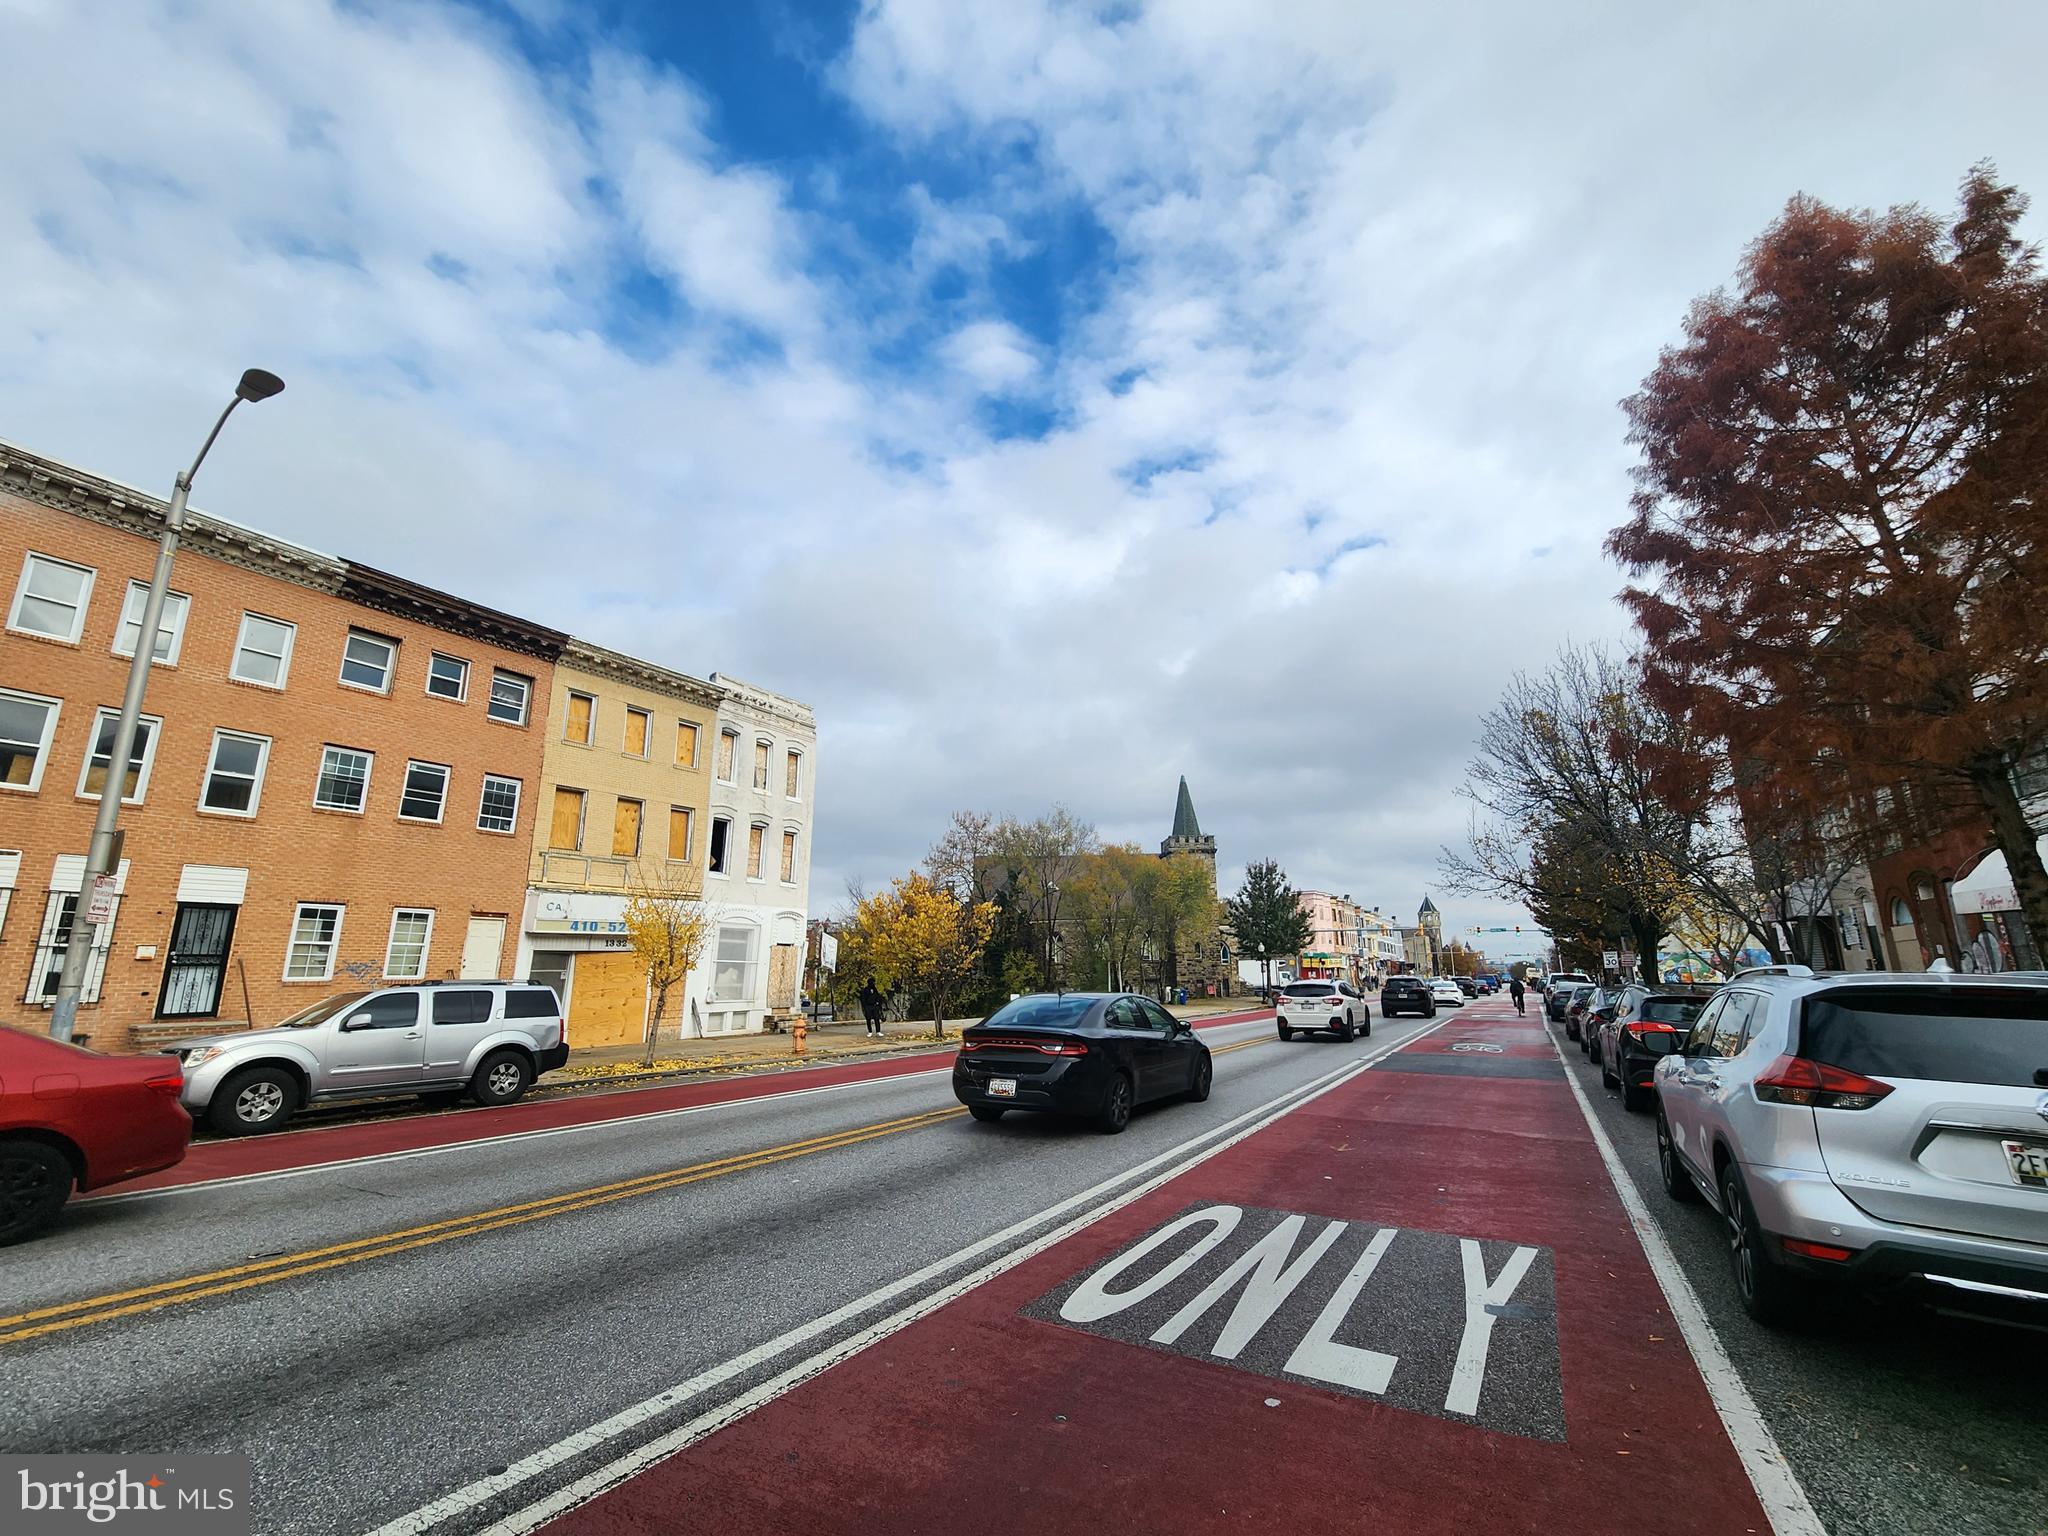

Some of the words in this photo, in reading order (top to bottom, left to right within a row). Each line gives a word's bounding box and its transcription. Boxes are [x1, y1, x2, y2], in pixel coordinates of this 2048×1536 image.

[605, 939, 628, 947] 1332
[2012, 1153, 2048, 1176] 2F
[1838, 1172, 1910, 1188] ROGUE
[1059, 1204, 1539, 1416] ONLY
